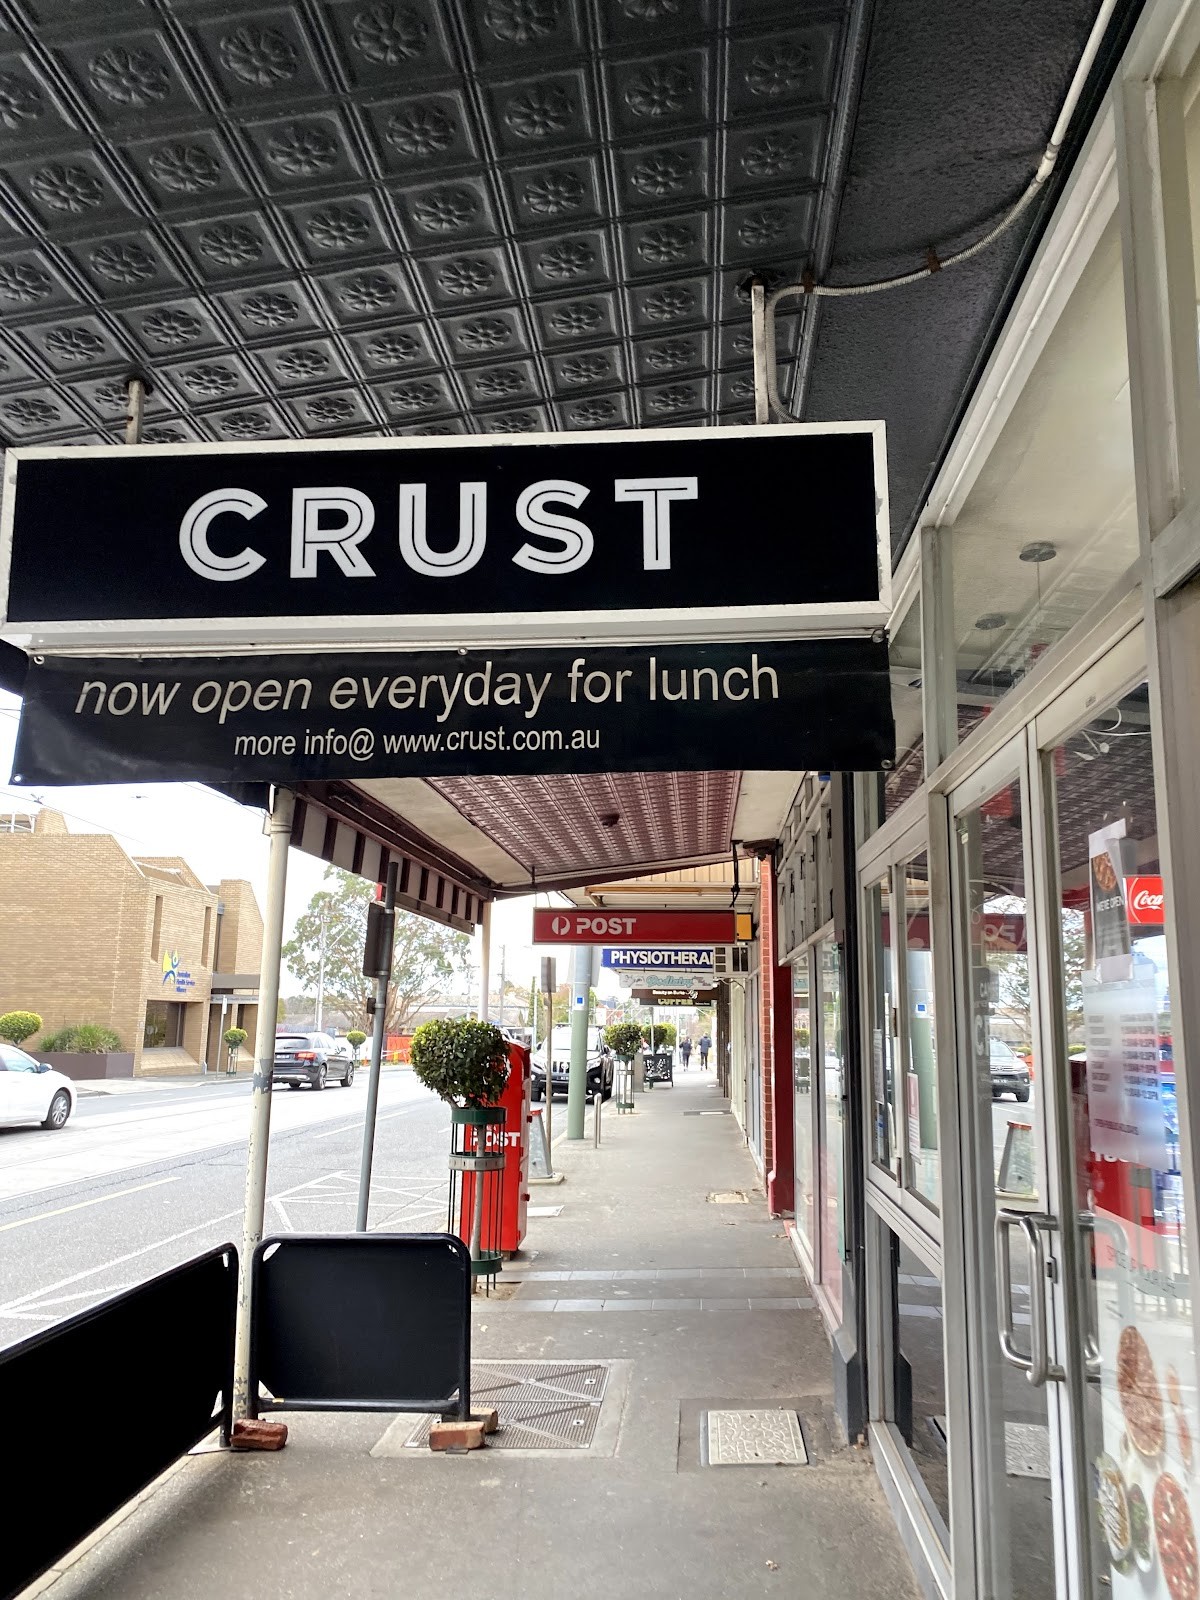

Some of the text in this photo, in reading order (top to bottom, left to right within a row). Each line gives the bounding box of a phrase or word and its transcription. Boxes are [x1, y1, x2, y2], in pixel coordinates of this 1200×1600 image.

[180, 477, 698, 581] CRUST
[75, 654, 779, 732] now open everyday for lunch
[235, 726, 600, 762] more info@ www.crust.com.au
[577, 918, 636, 935] POST
